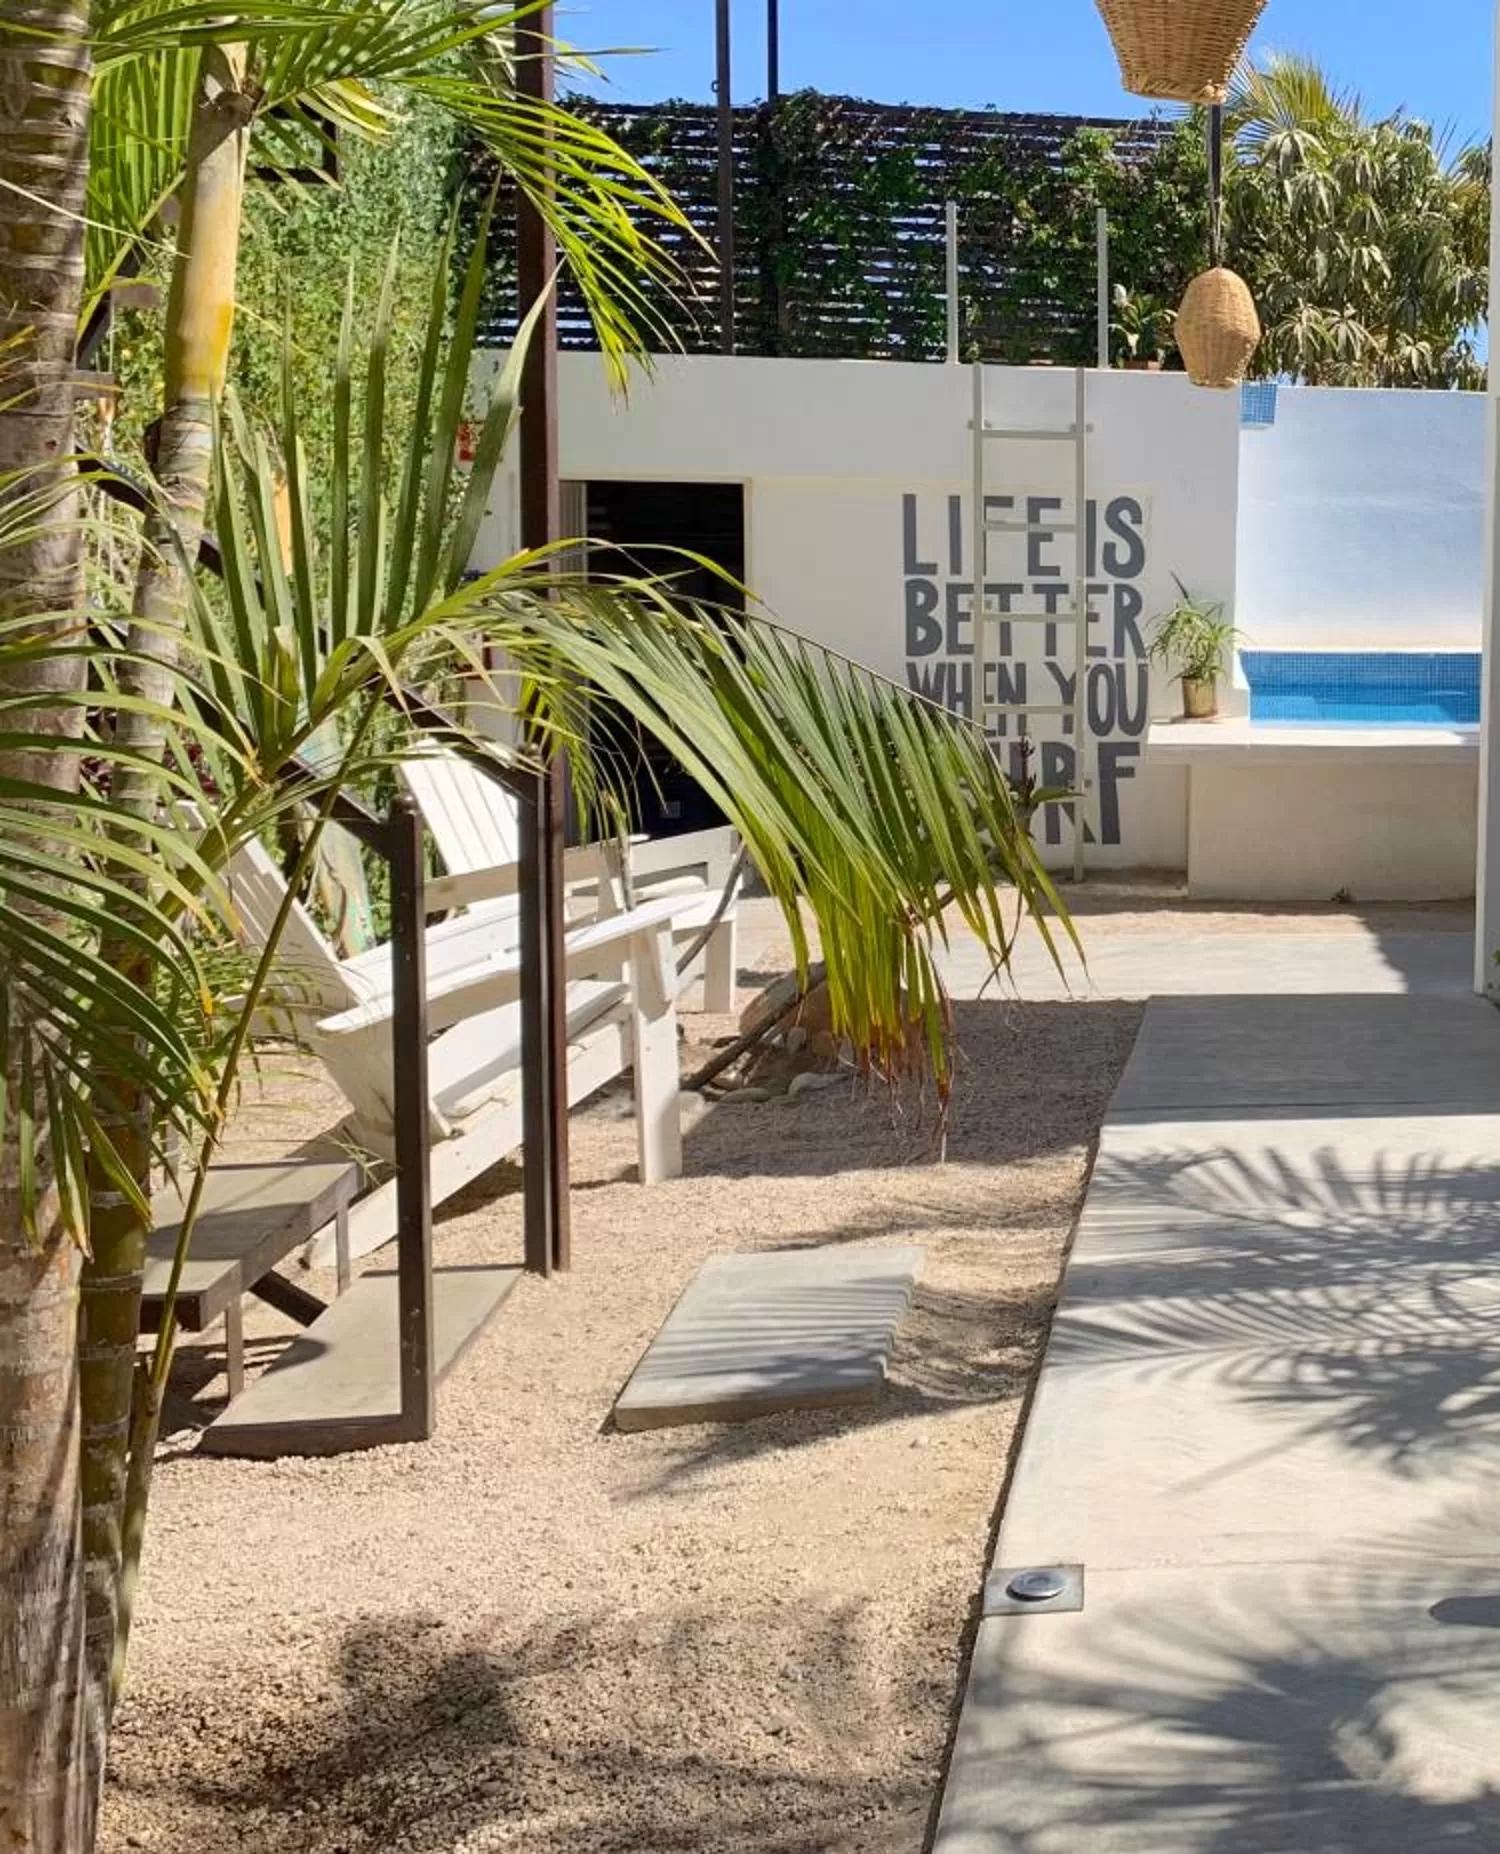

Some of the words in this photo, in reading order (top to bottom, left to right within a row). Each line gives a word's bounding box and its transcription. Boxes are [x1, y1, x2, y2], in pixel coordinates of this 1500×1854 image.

[902, 493, 1061, 577] LIFE
[1085, 496, 1146, 579] IS
[904, 578, 1148, 658] BETTER
[1044, 661, 1149, 738] YOU
